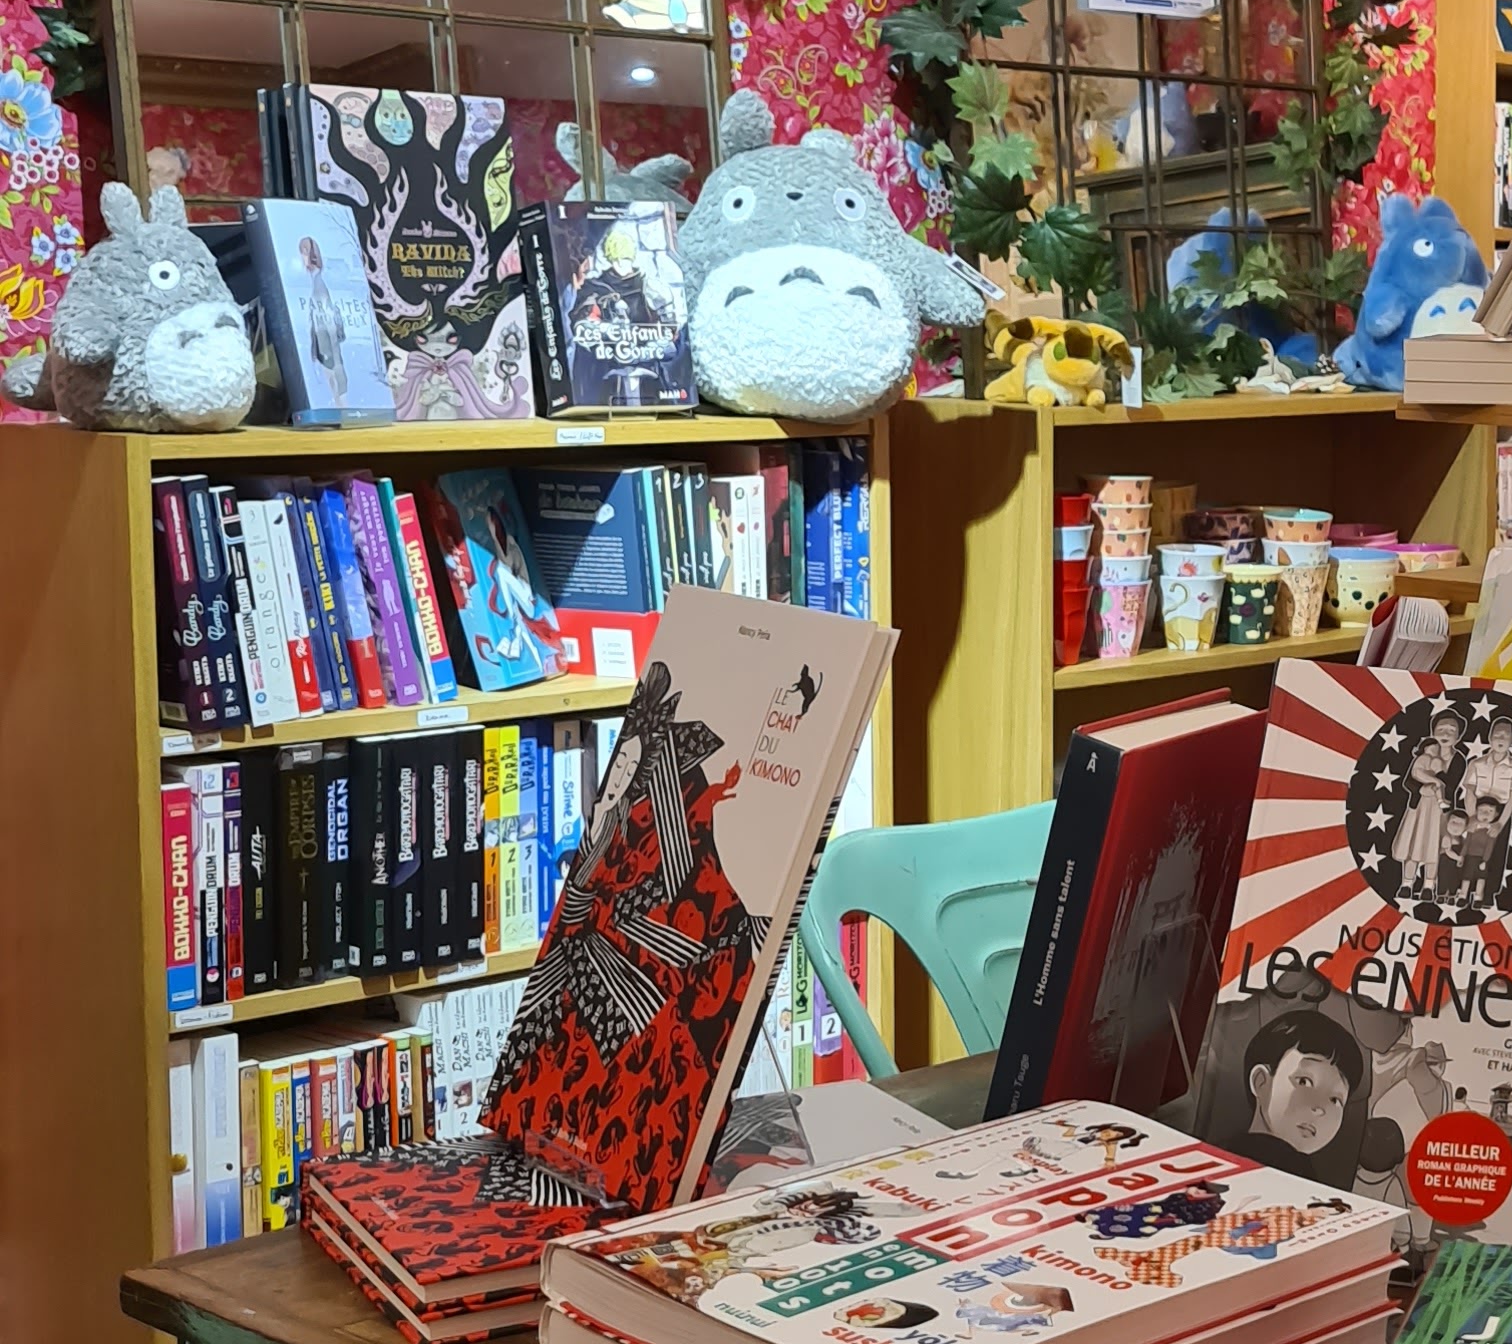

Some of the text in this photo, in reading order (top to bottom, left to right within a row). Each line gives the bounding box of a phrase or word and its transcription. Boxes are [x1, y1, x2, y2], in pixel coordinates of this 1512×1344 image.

[831, 522, 844, 580] PERFECT
[775, 687, 789, 706] LE
[767, 711, 802, 733] CHAT
[759, 735, 780, 754] DU
[749, 757, 801, 787] KIMONO
[336, 778, 349, 861] ORGAN
[1033, 859, 1077, 1007] L'Homme sans talent
[1338, 924, 1422, 958] NOUS
[799, 1025, 805, 1042] 1
[826, 1017, 836, 1036] 2
[1487, 1060, 1500, 1071] ET
[460, 1112, 468, 1125] 2
[1426, 1140, 1501, 1162] MEILLEUR
[1417, 1159, 1507, 1177] ROMAN GRAPHIQUE
[1424, 1173, 1497, 1192] DE L'ANNÉE
[864, 1177, 951, 1211] kabuki
[1020, 1243, 1133, 1290] kimono
